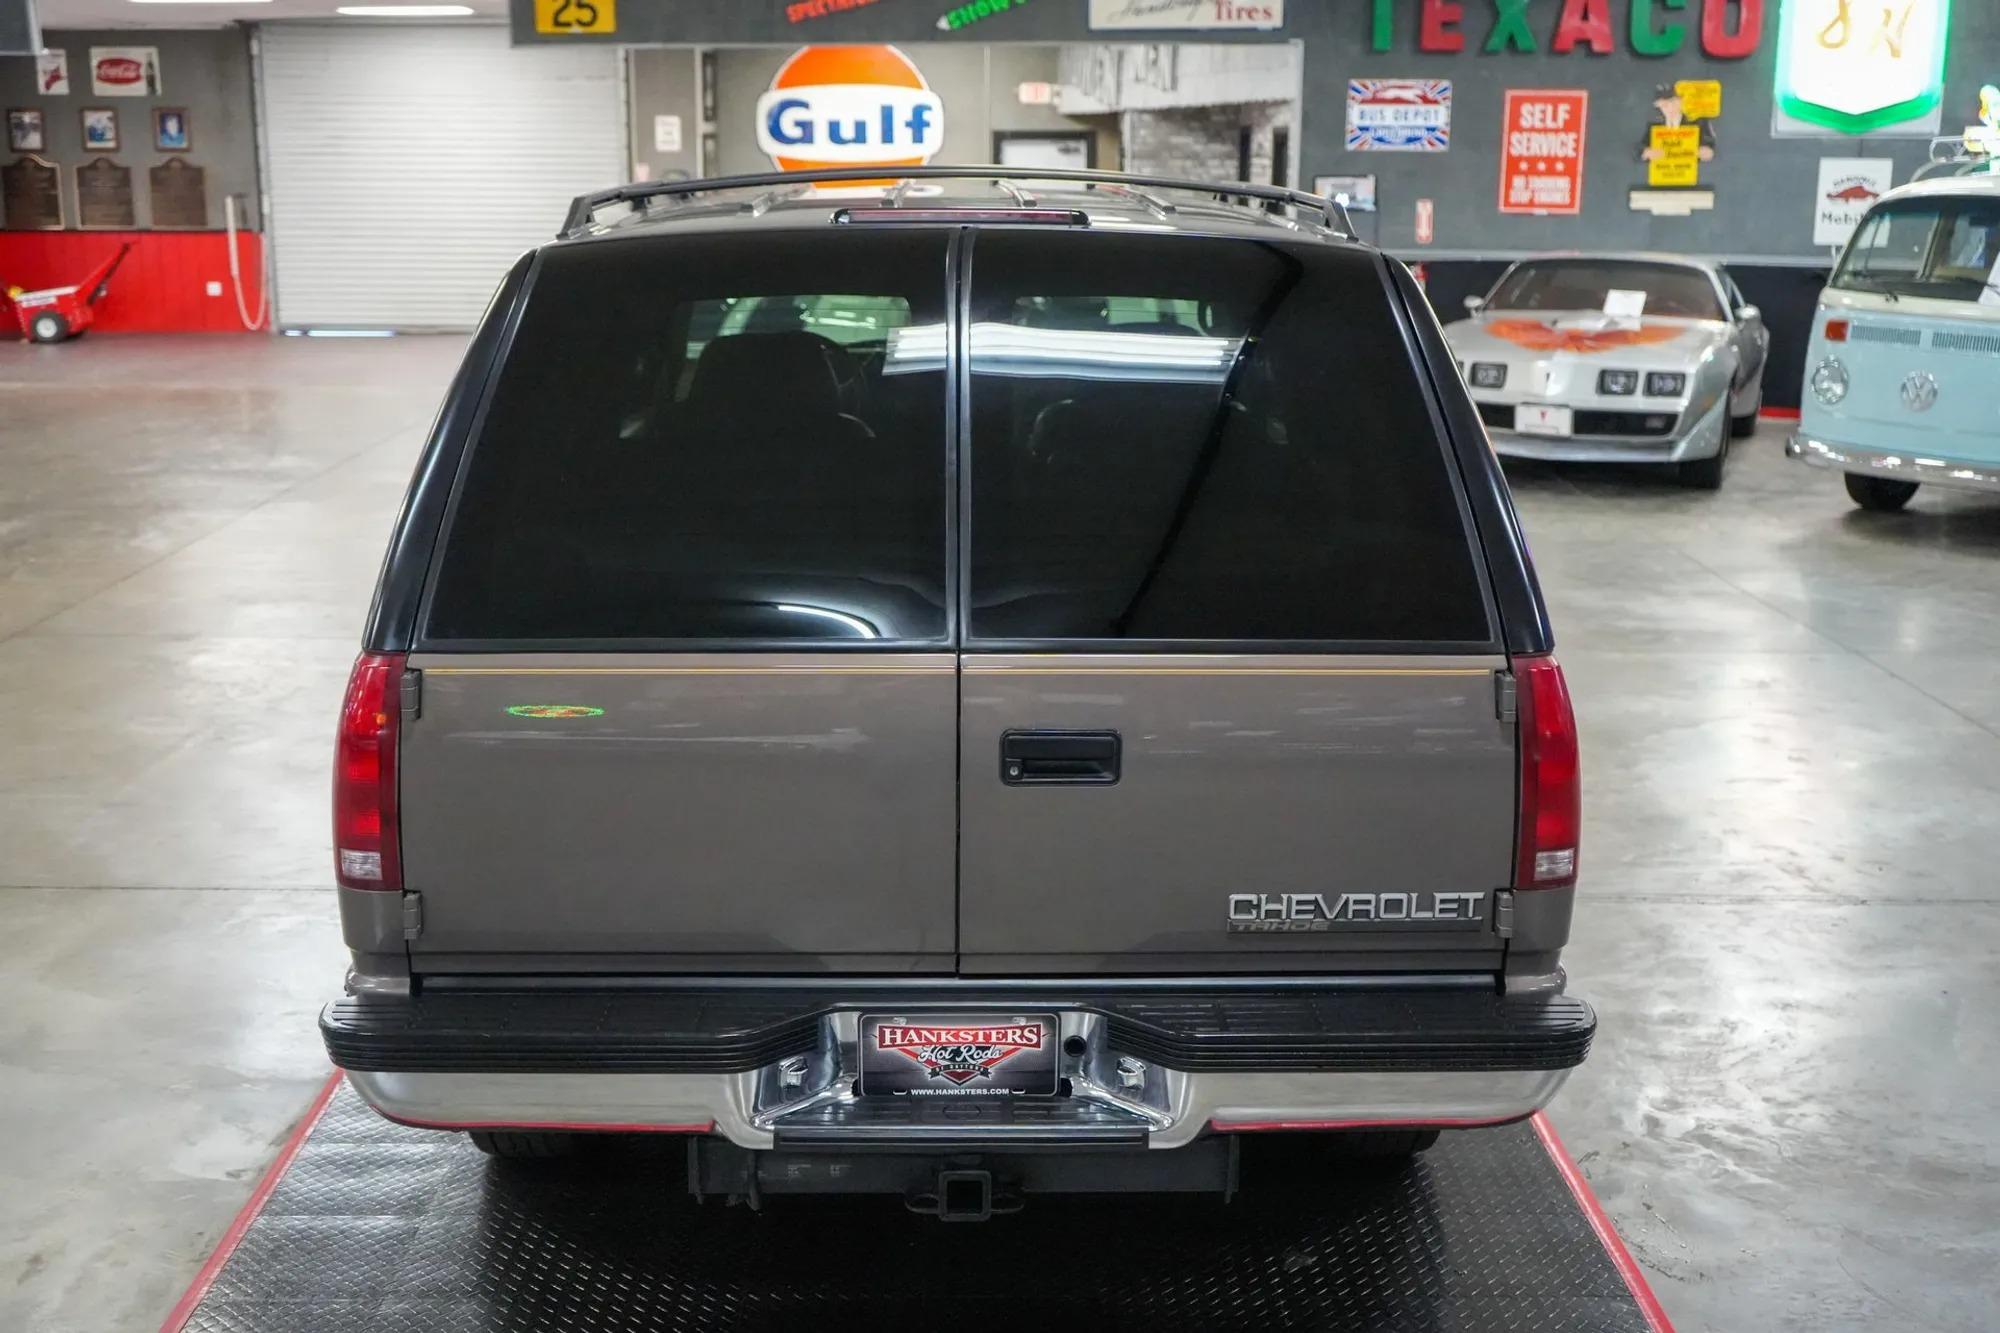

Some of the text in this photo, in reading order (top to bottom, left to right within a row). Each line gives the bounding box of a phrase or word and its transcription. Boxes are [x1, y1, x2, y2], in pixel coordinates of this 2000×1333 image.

[553, 0, 598, 28] 25
[1214, 0, 1273, 21] Tires
[766, 98, 933, 145] Gulf
[1520, 102, 1571, 129] SELF
[1509, 131, 1578, 158] SERVICE
[1228, 891, 1486, 920] CHEVROLET
[1236, 920, 1332, 932] TAHOE
[882, 1026, 1039, 1046] HANKSTERS
[917, 1044, 957, 1062] Hot
[910, 1088, 1010, 1096] WWW.HANKSTERS.COM
